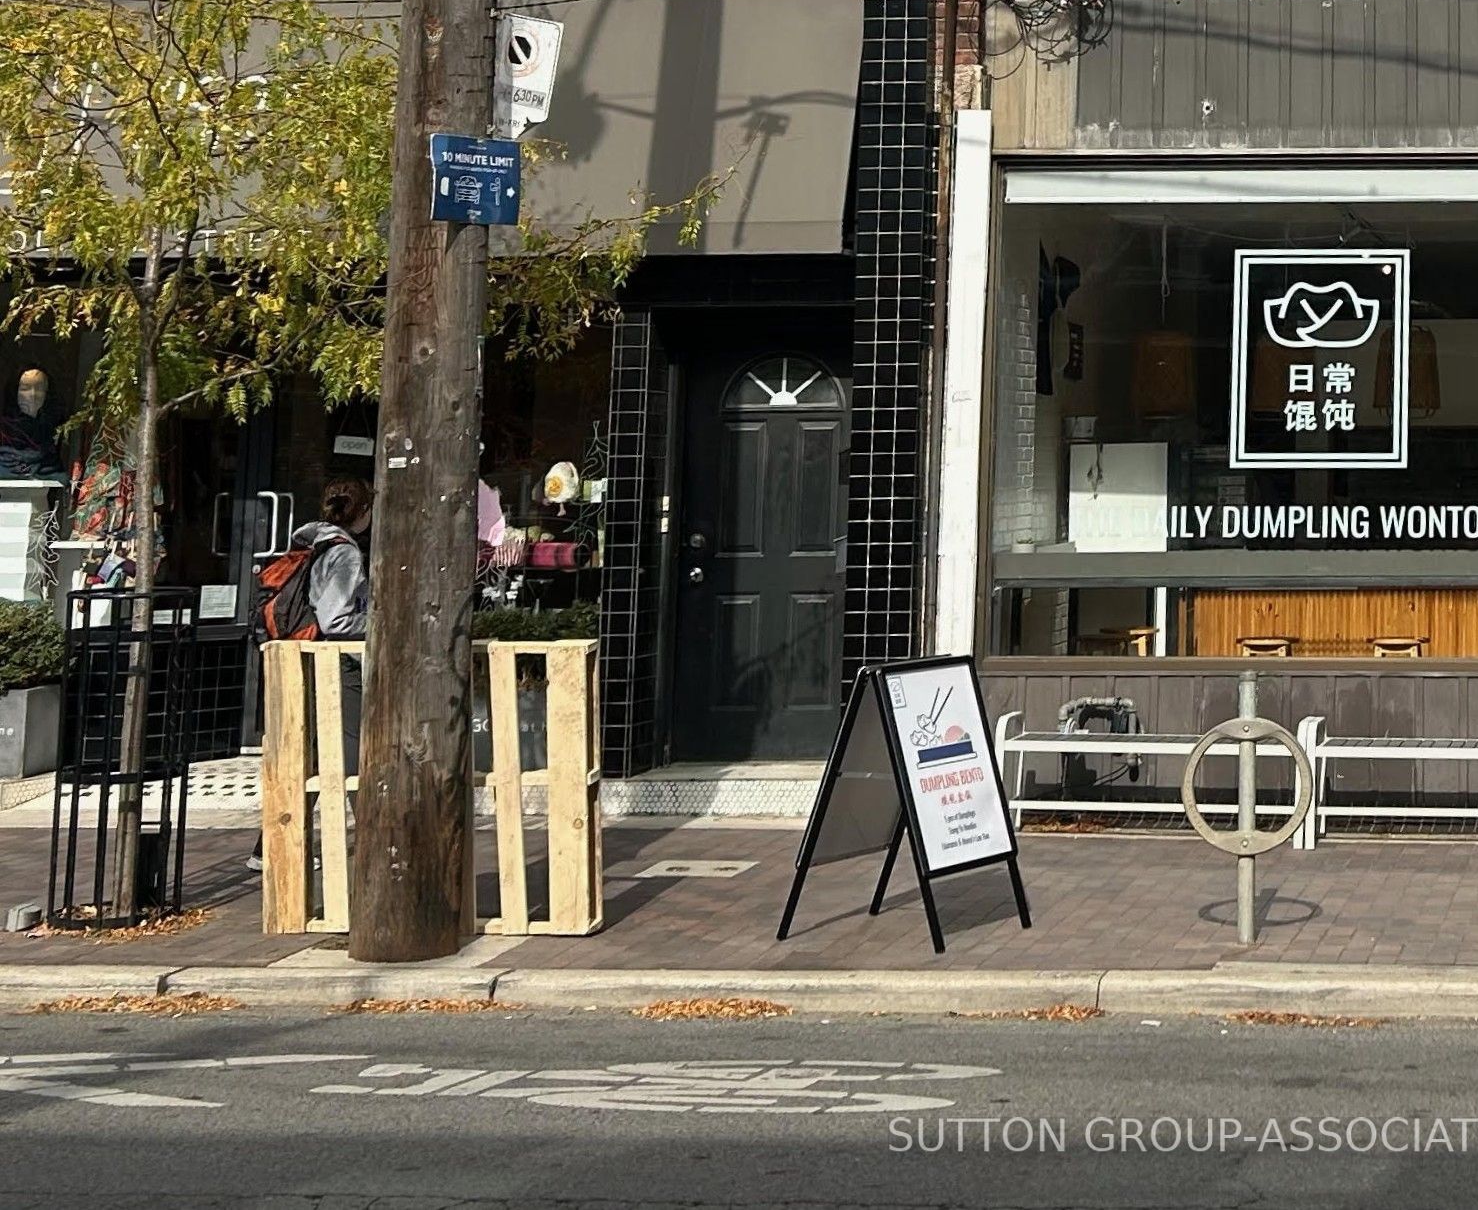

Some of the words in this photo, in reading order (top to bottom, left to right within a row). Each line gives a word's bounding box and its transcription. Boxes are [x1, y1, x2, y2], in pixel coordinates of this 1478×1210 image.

[455, 153, 487, 165] MINUTE
[490, 156, 514, 168] LIMIT
[1289, 362, 1355, 394] 日常
[1283, 398, 1356, 431] 馄饨
[1221, 505, 1370, 539] DUMPLING
